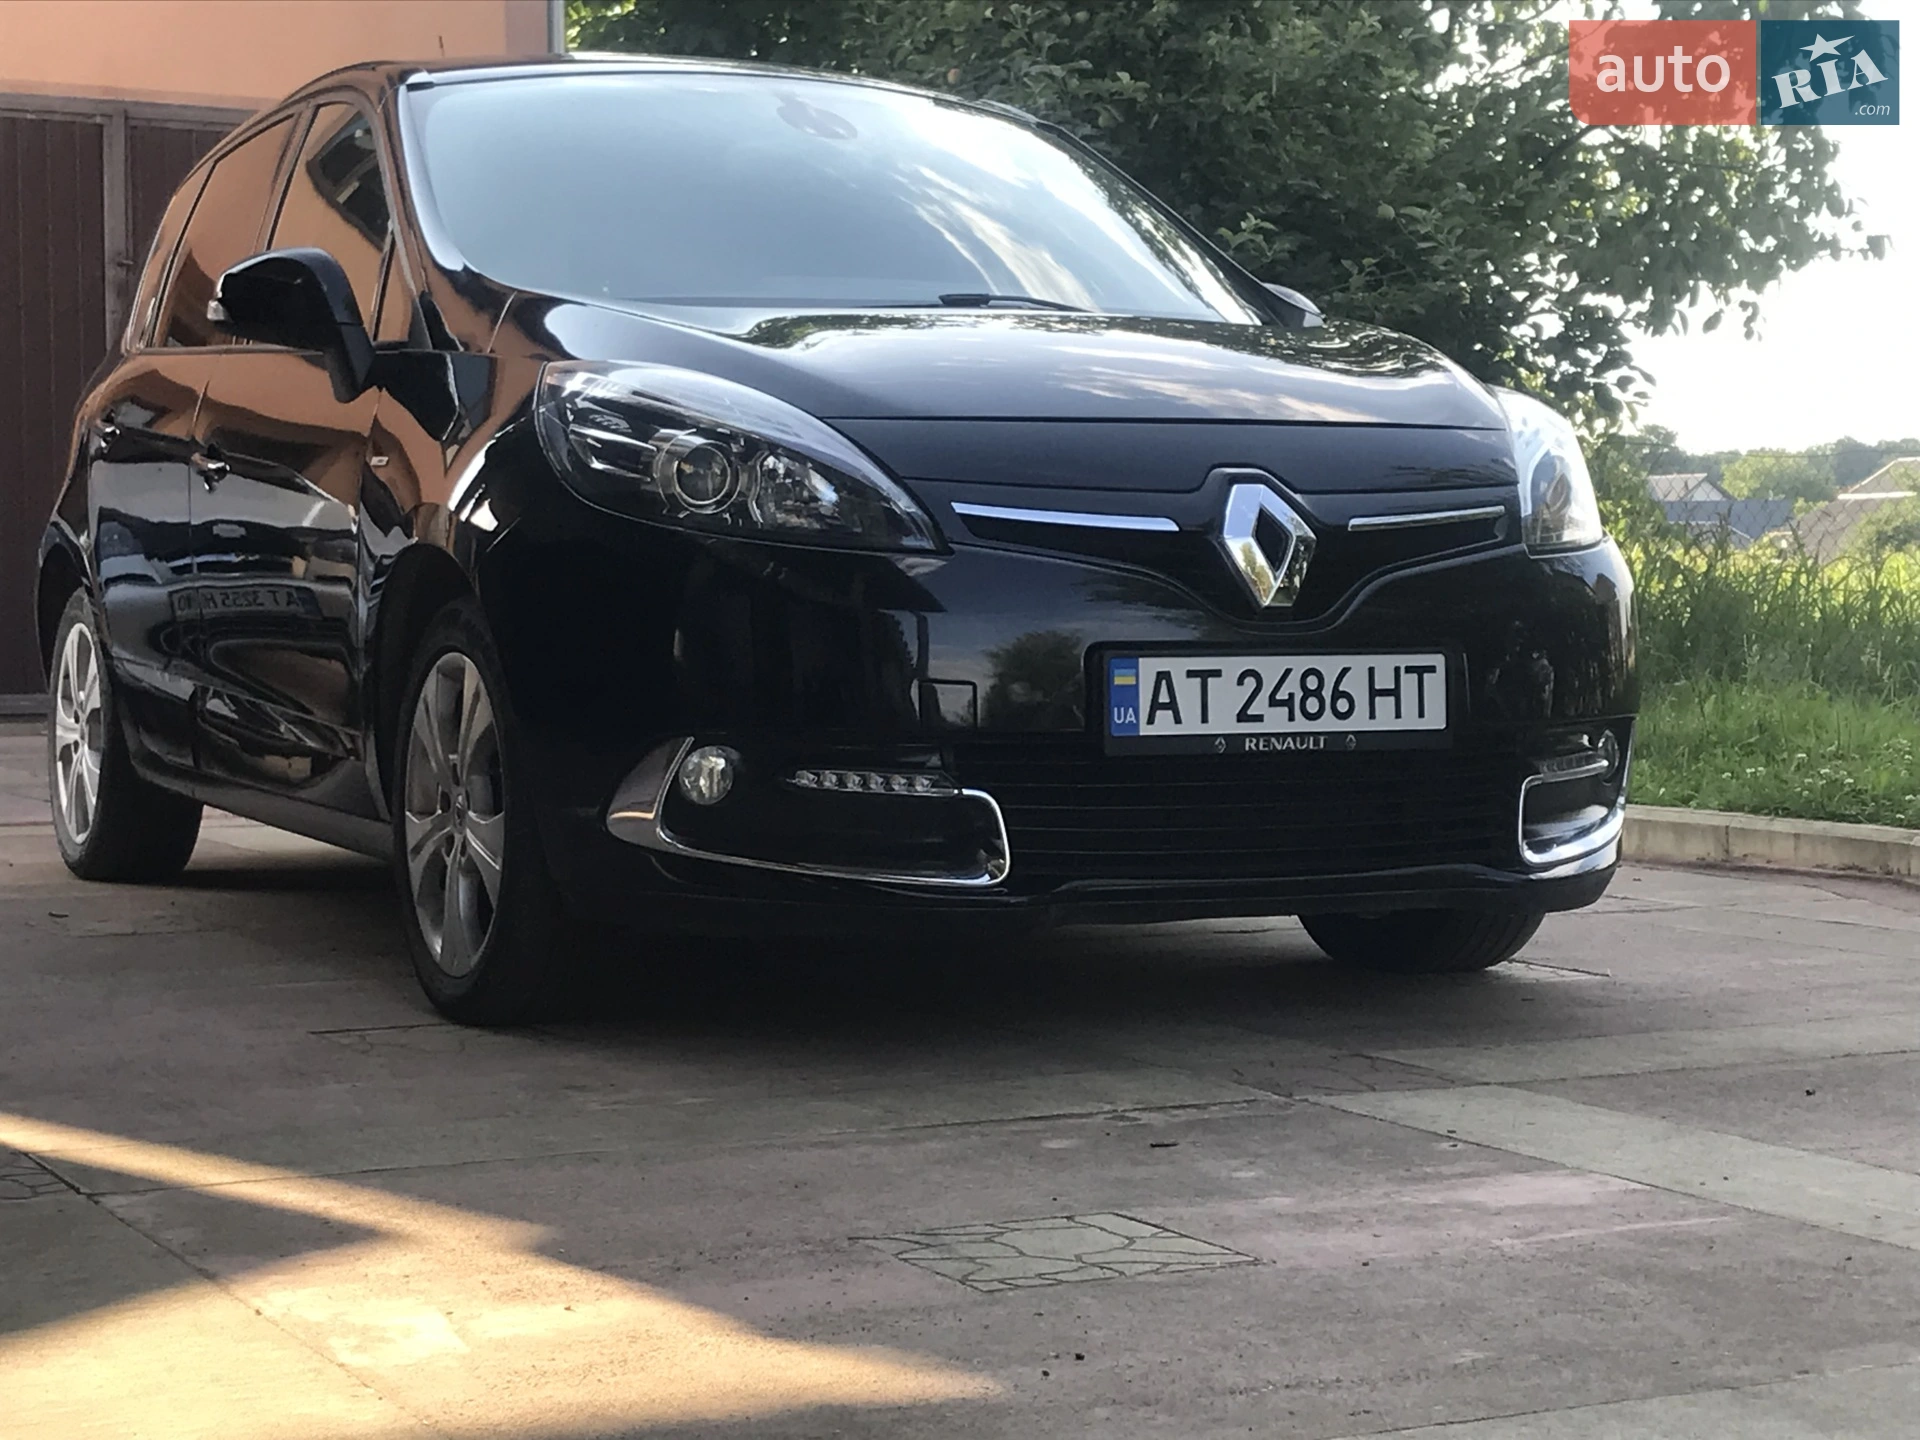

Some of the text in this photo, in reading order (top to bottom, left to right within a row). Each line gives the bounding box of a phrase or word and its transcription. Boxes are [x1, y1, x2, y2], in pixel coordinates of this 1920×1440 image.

[1146, 665, 1437, 726] AT 2486 HT
[1113, 706, 1137, 725] UA
[1244, 736, 1329, 751] RENAULT
